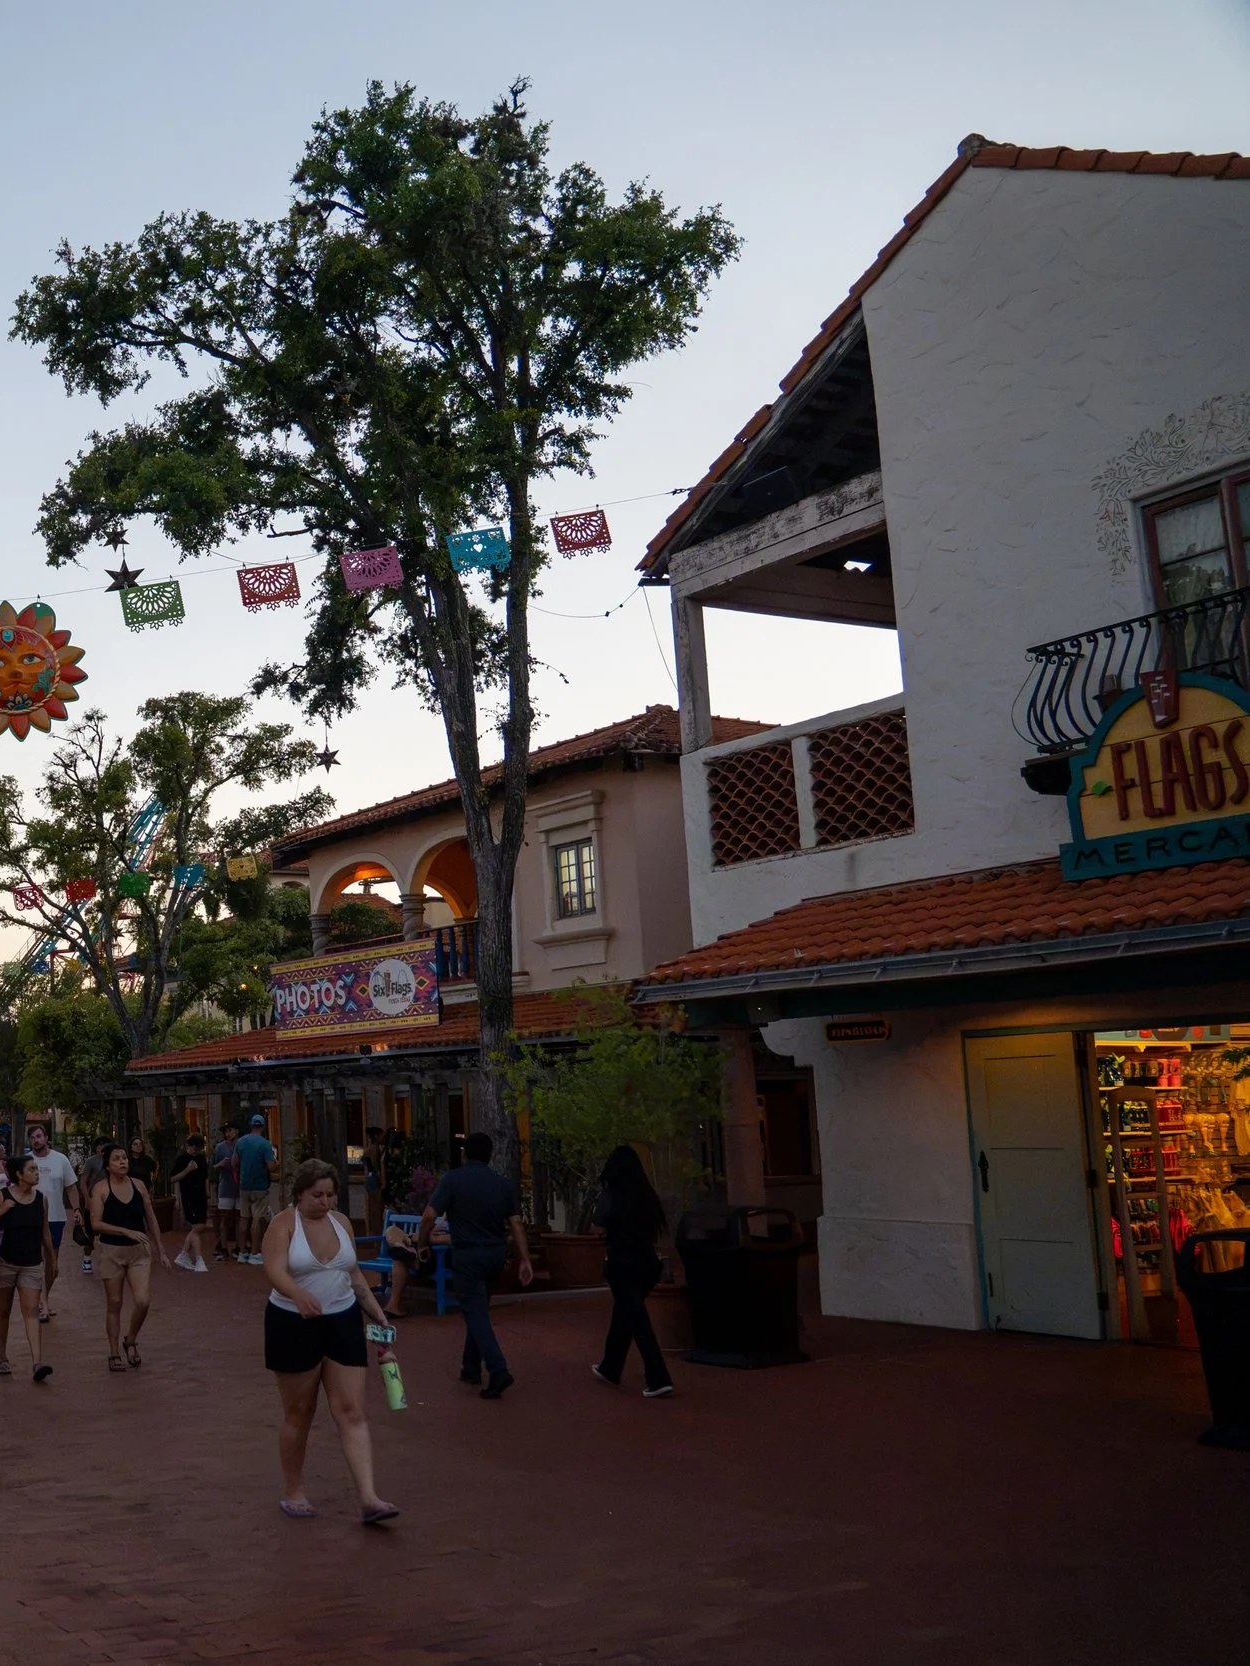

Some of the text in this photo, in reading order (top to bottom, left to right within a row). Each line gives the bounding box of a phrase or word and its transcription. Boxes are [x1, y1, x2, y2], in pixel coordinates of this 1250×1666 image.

[1111, 720, 1250, 821] FLAGS
[1073, 821, 1250, 871] MERCA
[276, 979, 346, 1012] PHOTOS
[373, 981, 412, 998] Six Flags
